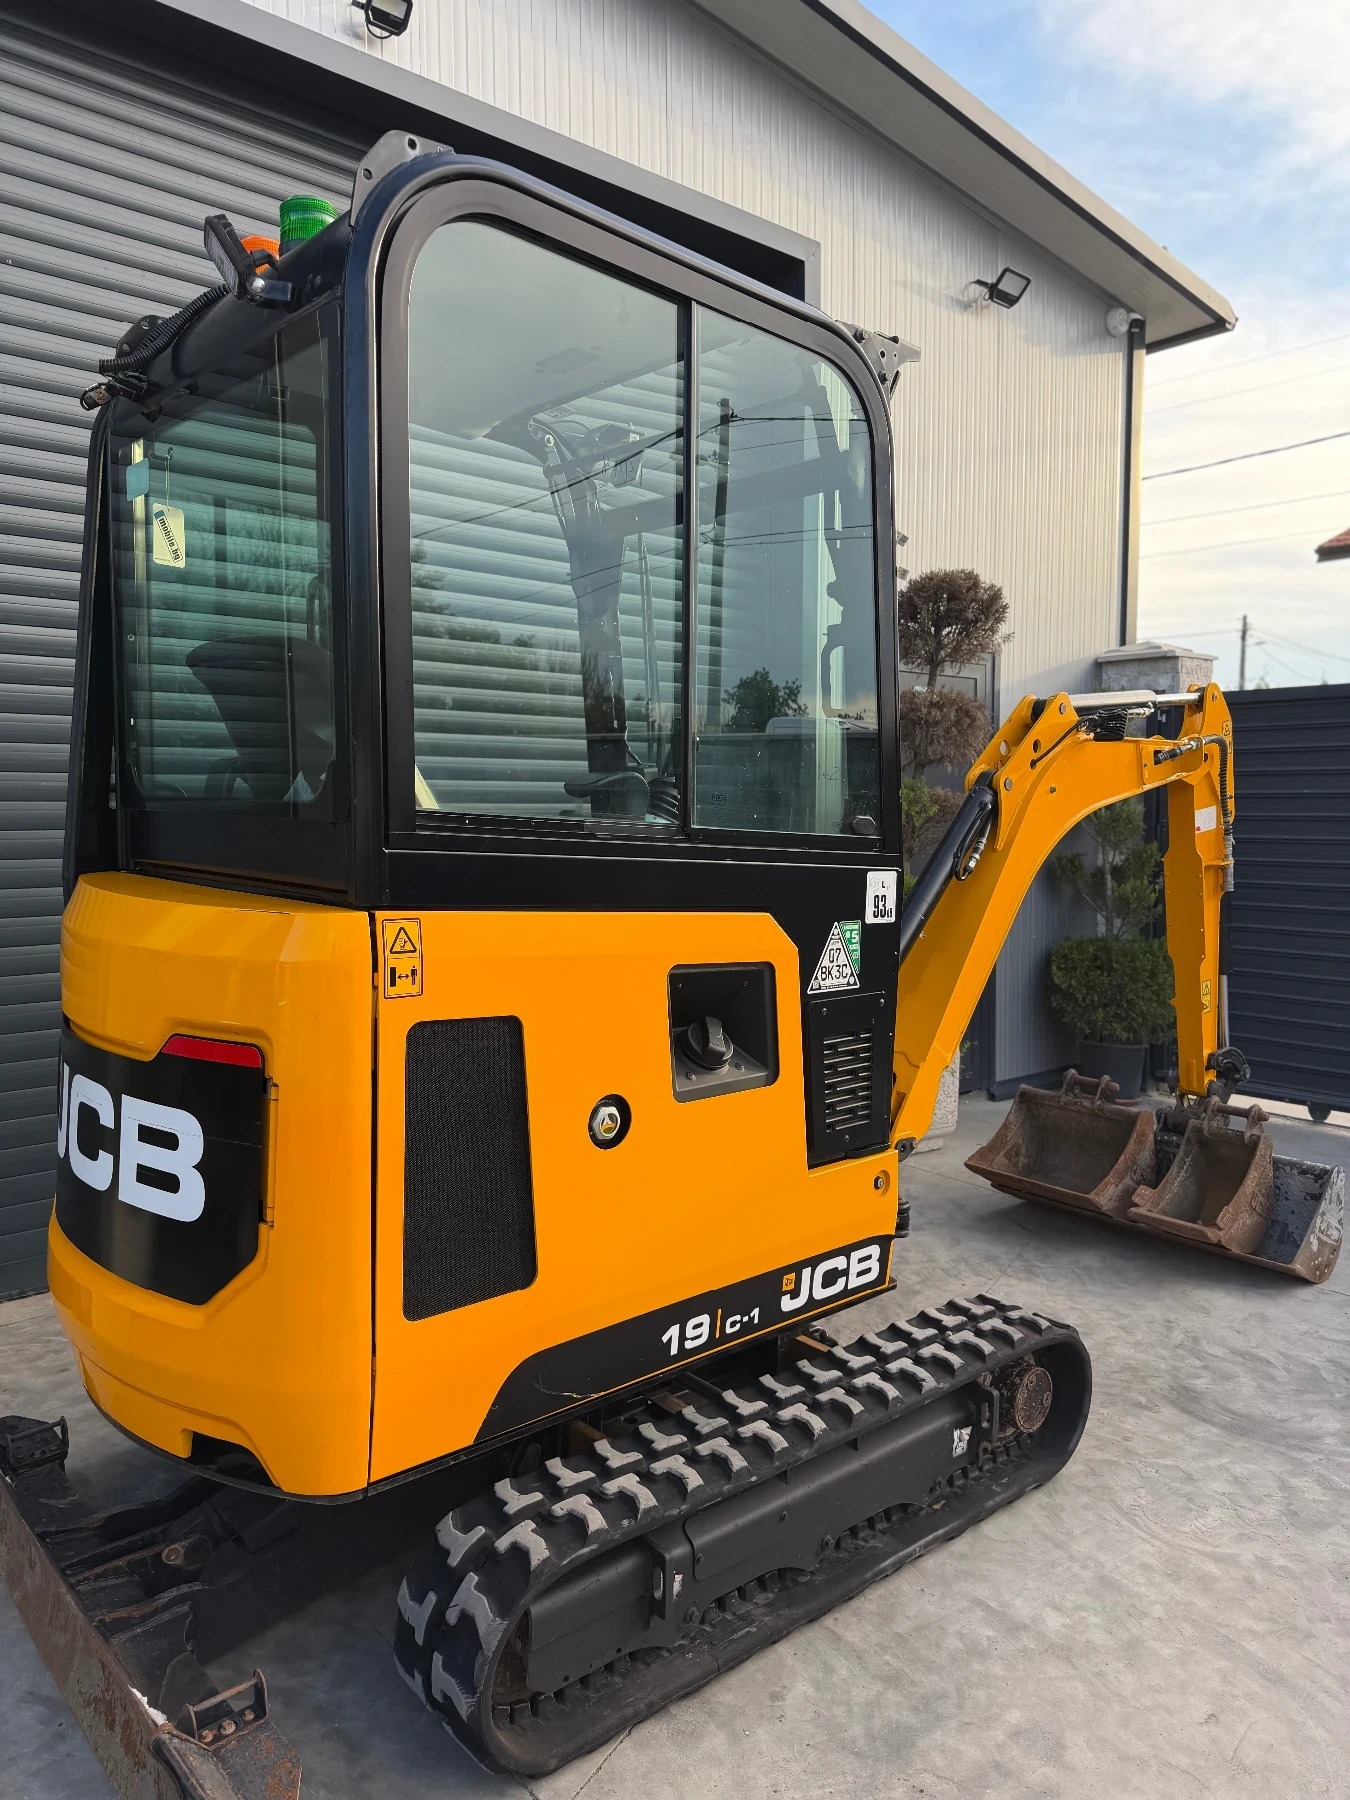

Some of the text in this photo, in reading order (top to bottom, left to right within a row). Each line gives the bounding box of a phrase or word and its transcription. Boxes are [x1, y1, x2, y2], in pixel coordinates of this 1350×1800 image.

[159, 517, 181, 561] mobile.bg
[780, 1244, 881, 1312] JCB
[661, 1306, 760, 1356] 19 C-1
